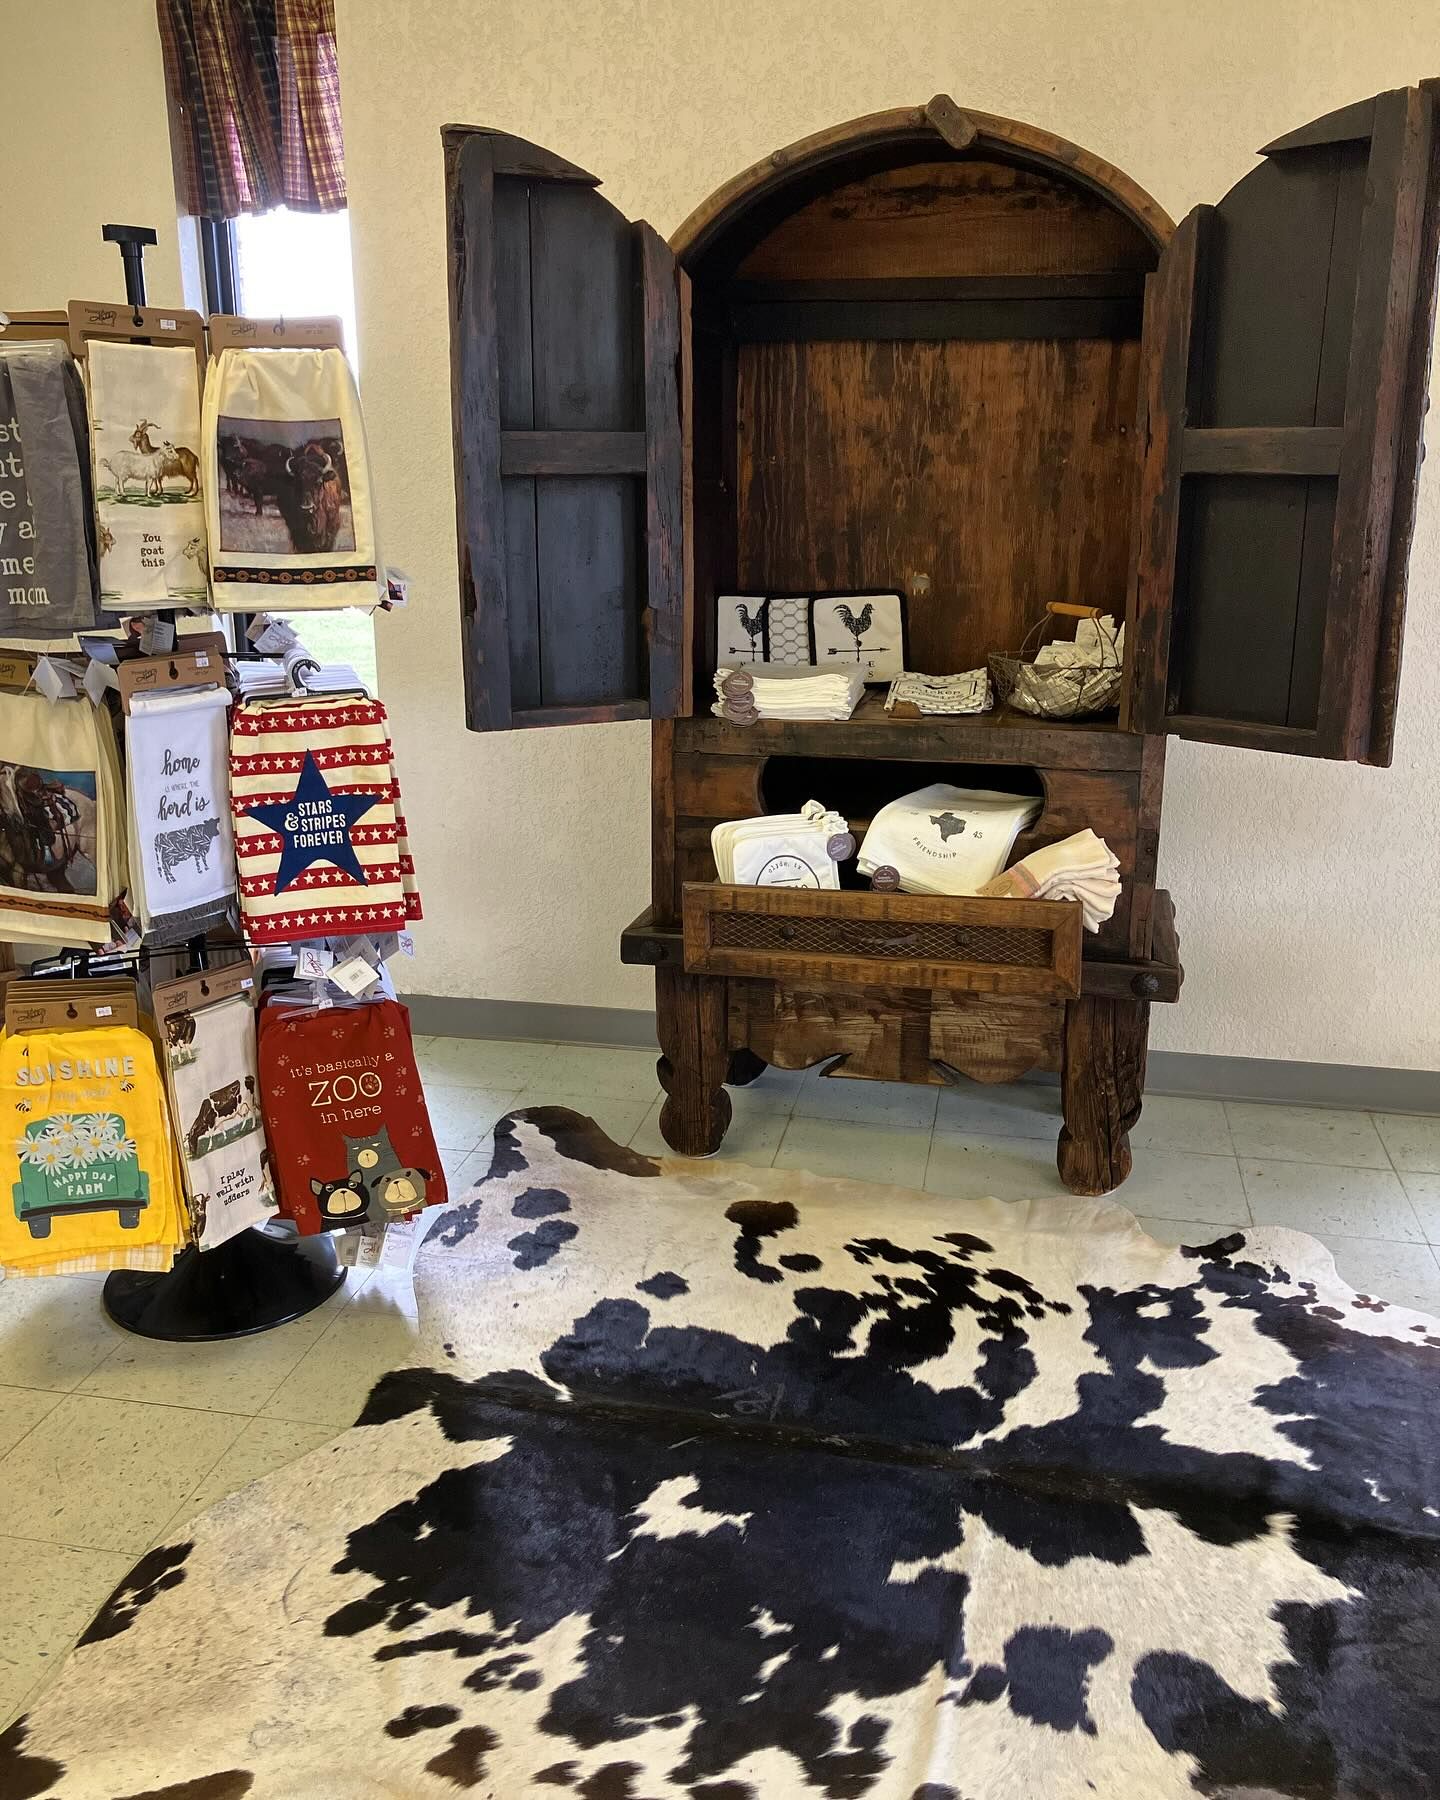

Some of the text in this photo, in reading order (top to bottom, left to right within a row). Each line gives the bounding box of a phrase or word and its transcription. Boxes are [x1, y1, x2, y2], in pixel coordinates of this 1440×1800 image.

[142, 533, 162, 543] You
[140, 545, 165, 557] goat
[140, 557, 166, 568] this
[160, 748, 201, 777] home
[195, 796, 211, 812] is
[298, 799, 333, 817] STARS
[284, 812, 346, 832] & STRIPES
[293, 830, 344, 849] FOREVER
[912, 836, 958, 860] FRIENDSHIP
[289, 1051, 396, 1079] it's basically a
[308, 1071, 383, 1107] ZOO
[320, 1104, 383, 1124] in here
[52, 1170, 116, 1189] HAPPY DAY
[220, 1167, 246, 1185] I play
[67, 1182, 104, 1197] FARM
[215, 1175, 255, 1199] well with
[223, 1188, 251, 1206] udders
